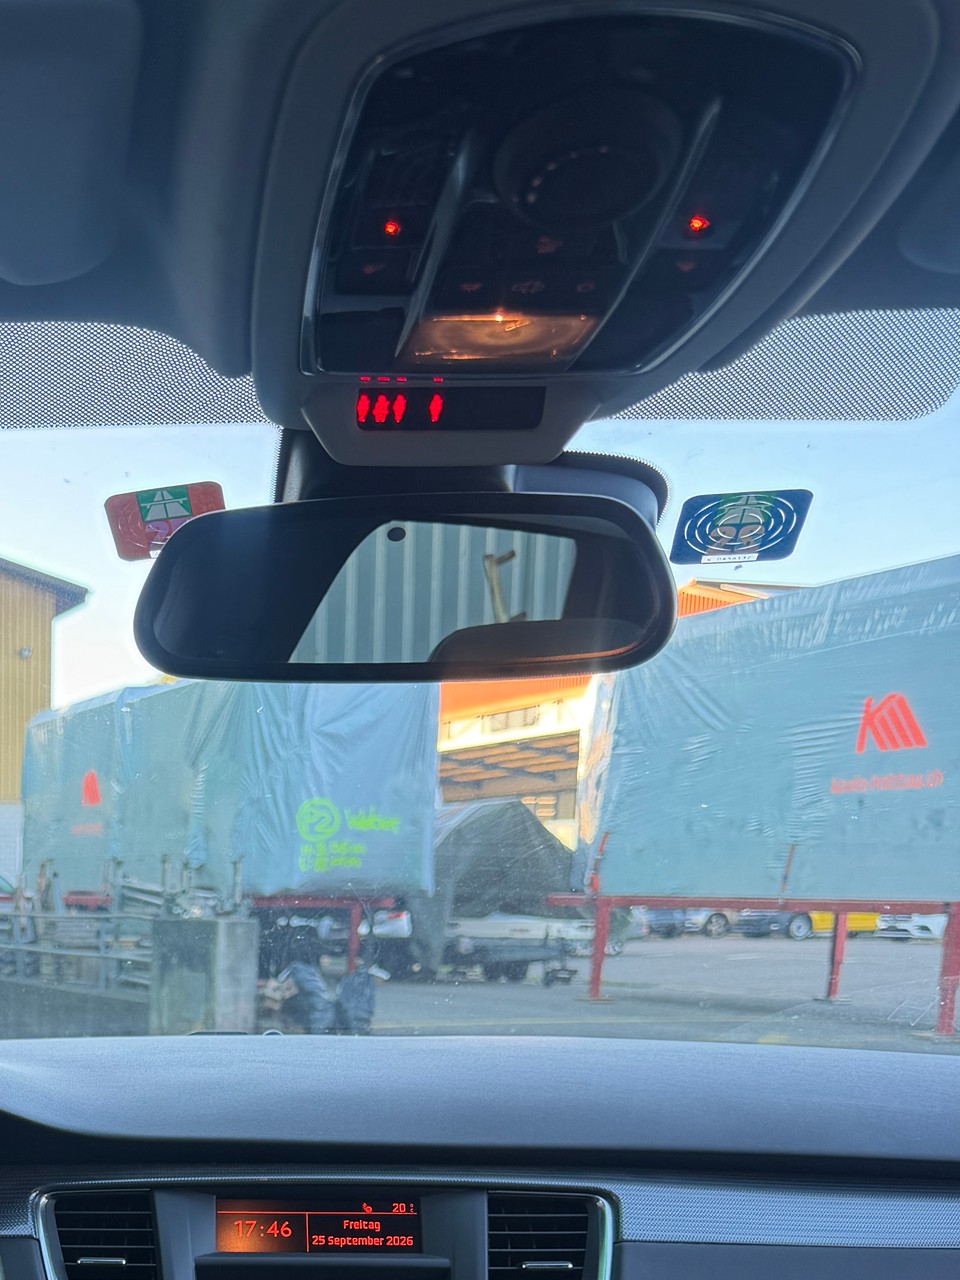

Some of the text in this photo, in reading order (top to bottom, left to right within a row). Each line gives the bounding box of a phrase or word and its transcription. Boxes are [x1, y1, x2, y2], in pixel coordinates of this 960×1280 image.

[392, 1203, 406, 1213] 20
[234, 1220, 292, 1238] 17:46
[343, 1219, 381, 1232] Freitag
[312, 1235, 414, 1248] 25 September 2026
